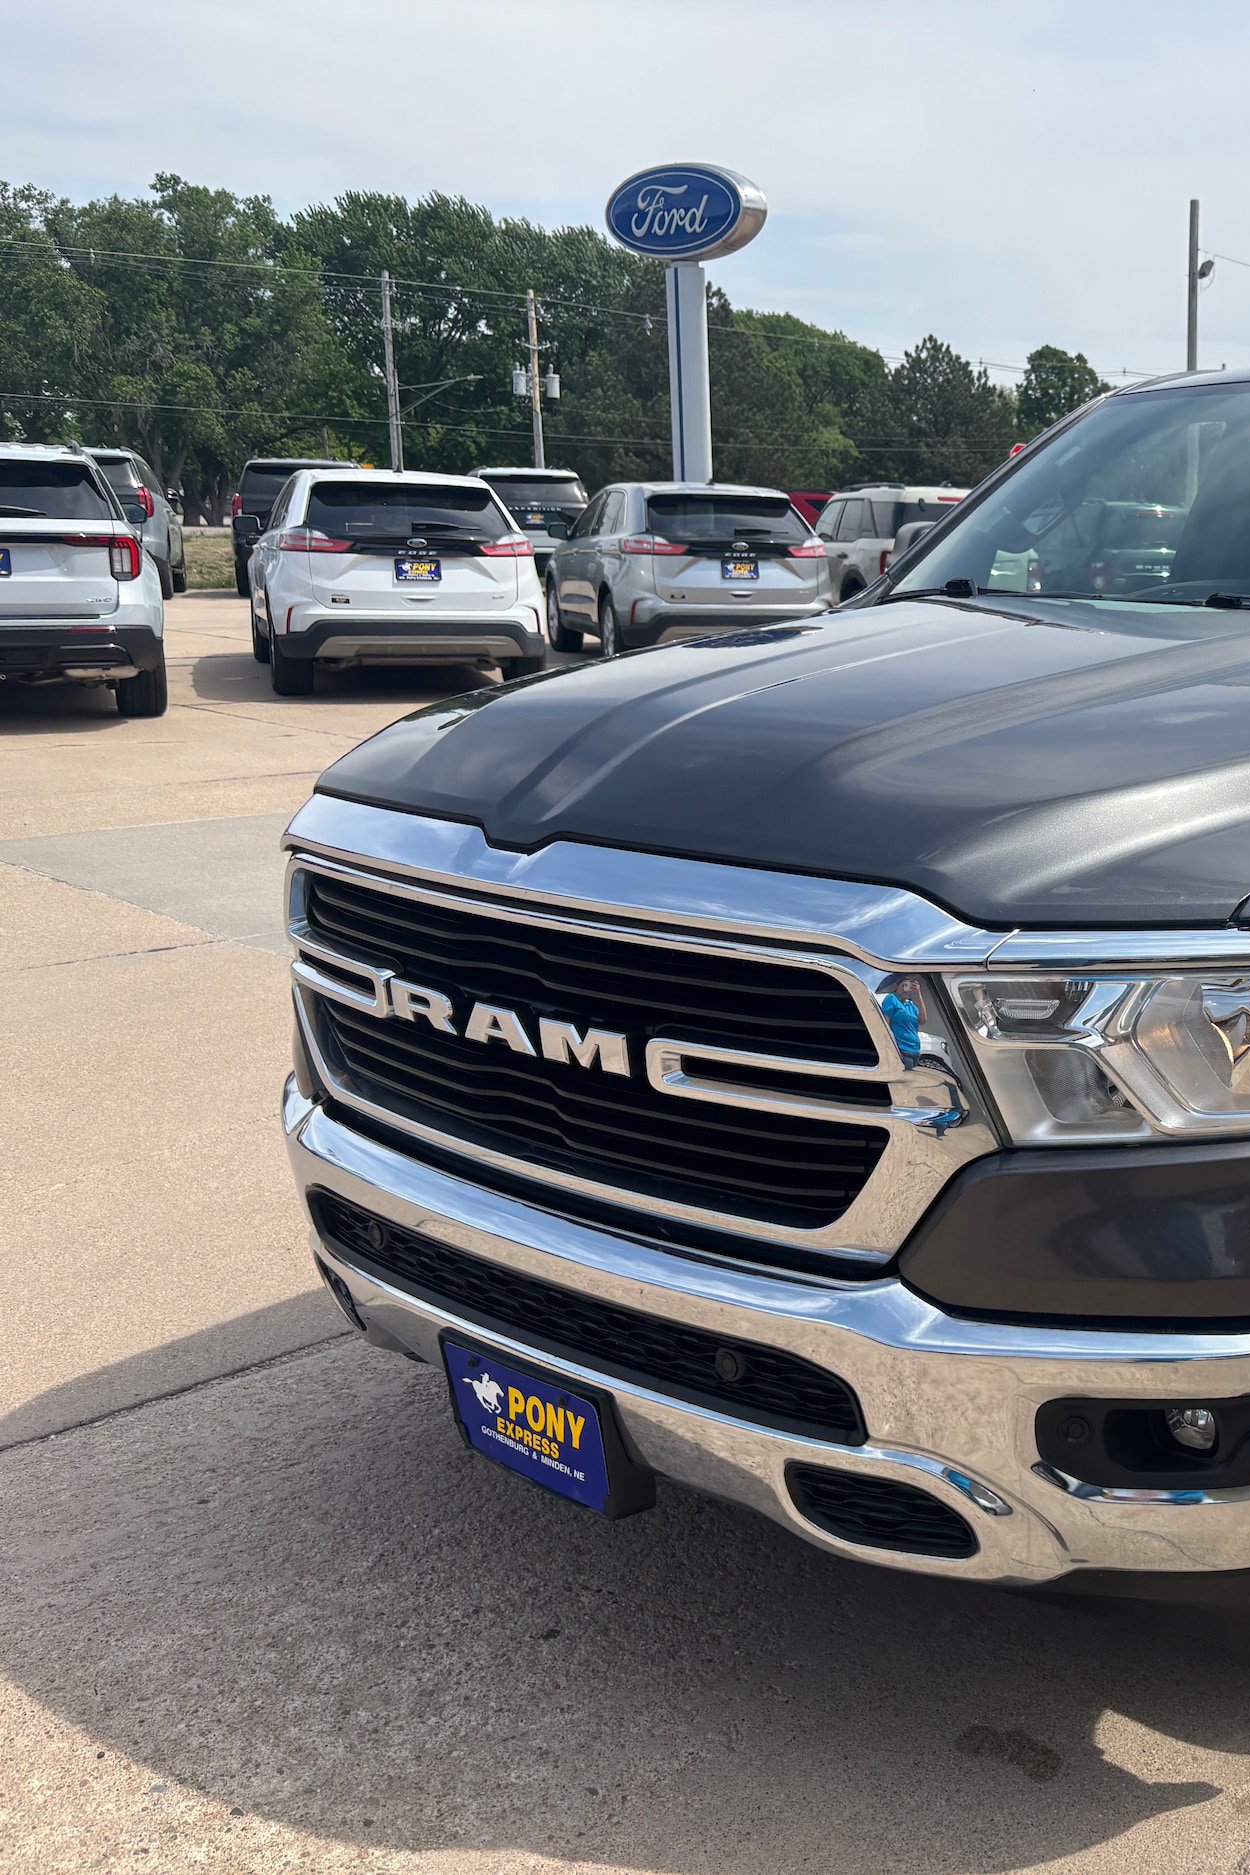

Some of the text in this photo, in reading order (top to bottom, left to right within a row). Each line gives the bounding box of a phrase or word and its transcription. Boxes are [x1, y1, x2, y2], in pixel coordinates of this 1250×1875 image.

[631, 184, 710, 238] Ford
[390, 977, 631, 1078] RAM
[497, 1417, 560, 1460] EXPRESS
[507, 1386, 586, 1449] PONY
[481, 1425, 530, 1456] GOTHENBURG
[532, 1452, 538, 1460] &
[573, 1469, 586, 1482] NE
